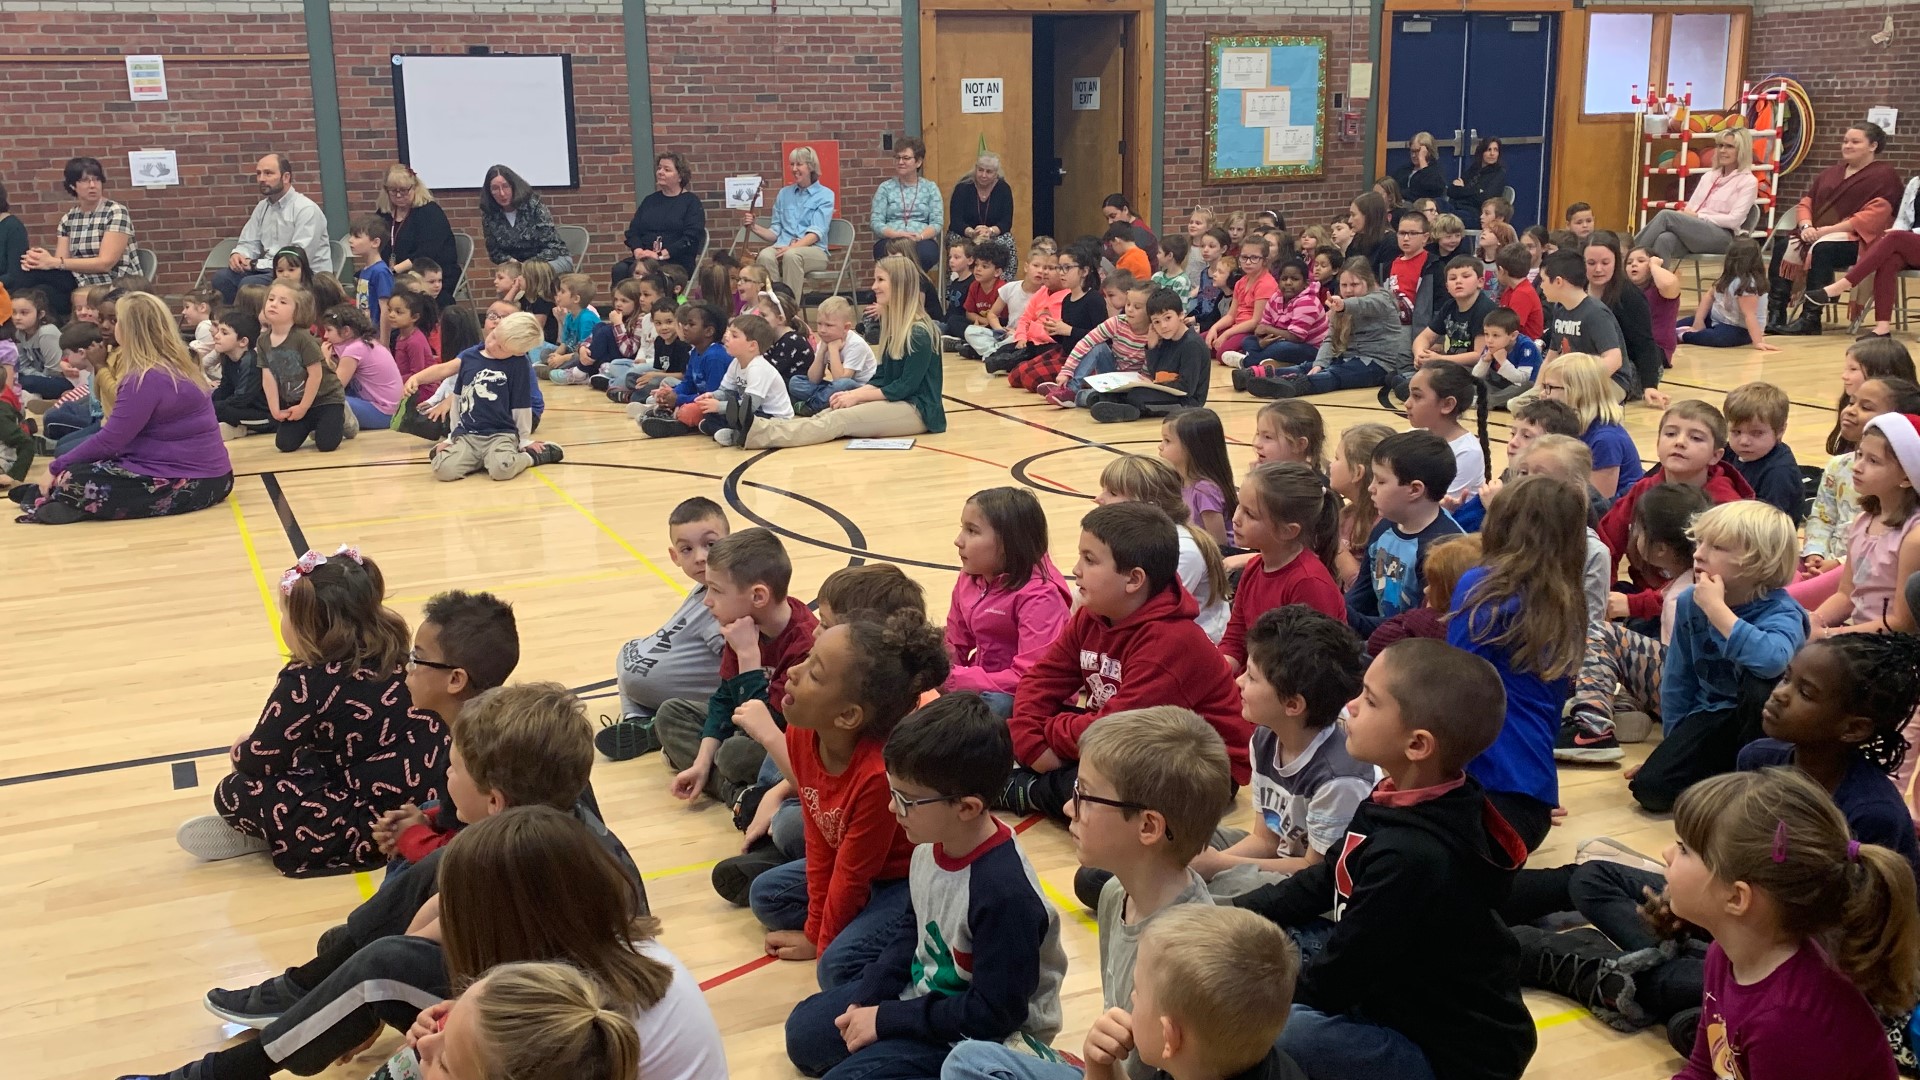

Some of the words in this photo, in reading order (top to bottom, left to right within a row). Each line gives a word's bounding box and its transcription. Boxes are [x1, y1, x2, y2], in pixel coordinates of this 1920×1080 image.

[965, 82, 984, 94] NOT
[987, 82, 999, 94] AN
[1074, 81, 1087, 92] NOT
[1088, 81, 1098, 92] AN
[972, 95, 993, 107] EXIT
[1079, 93, 1093, 105] EXIT
